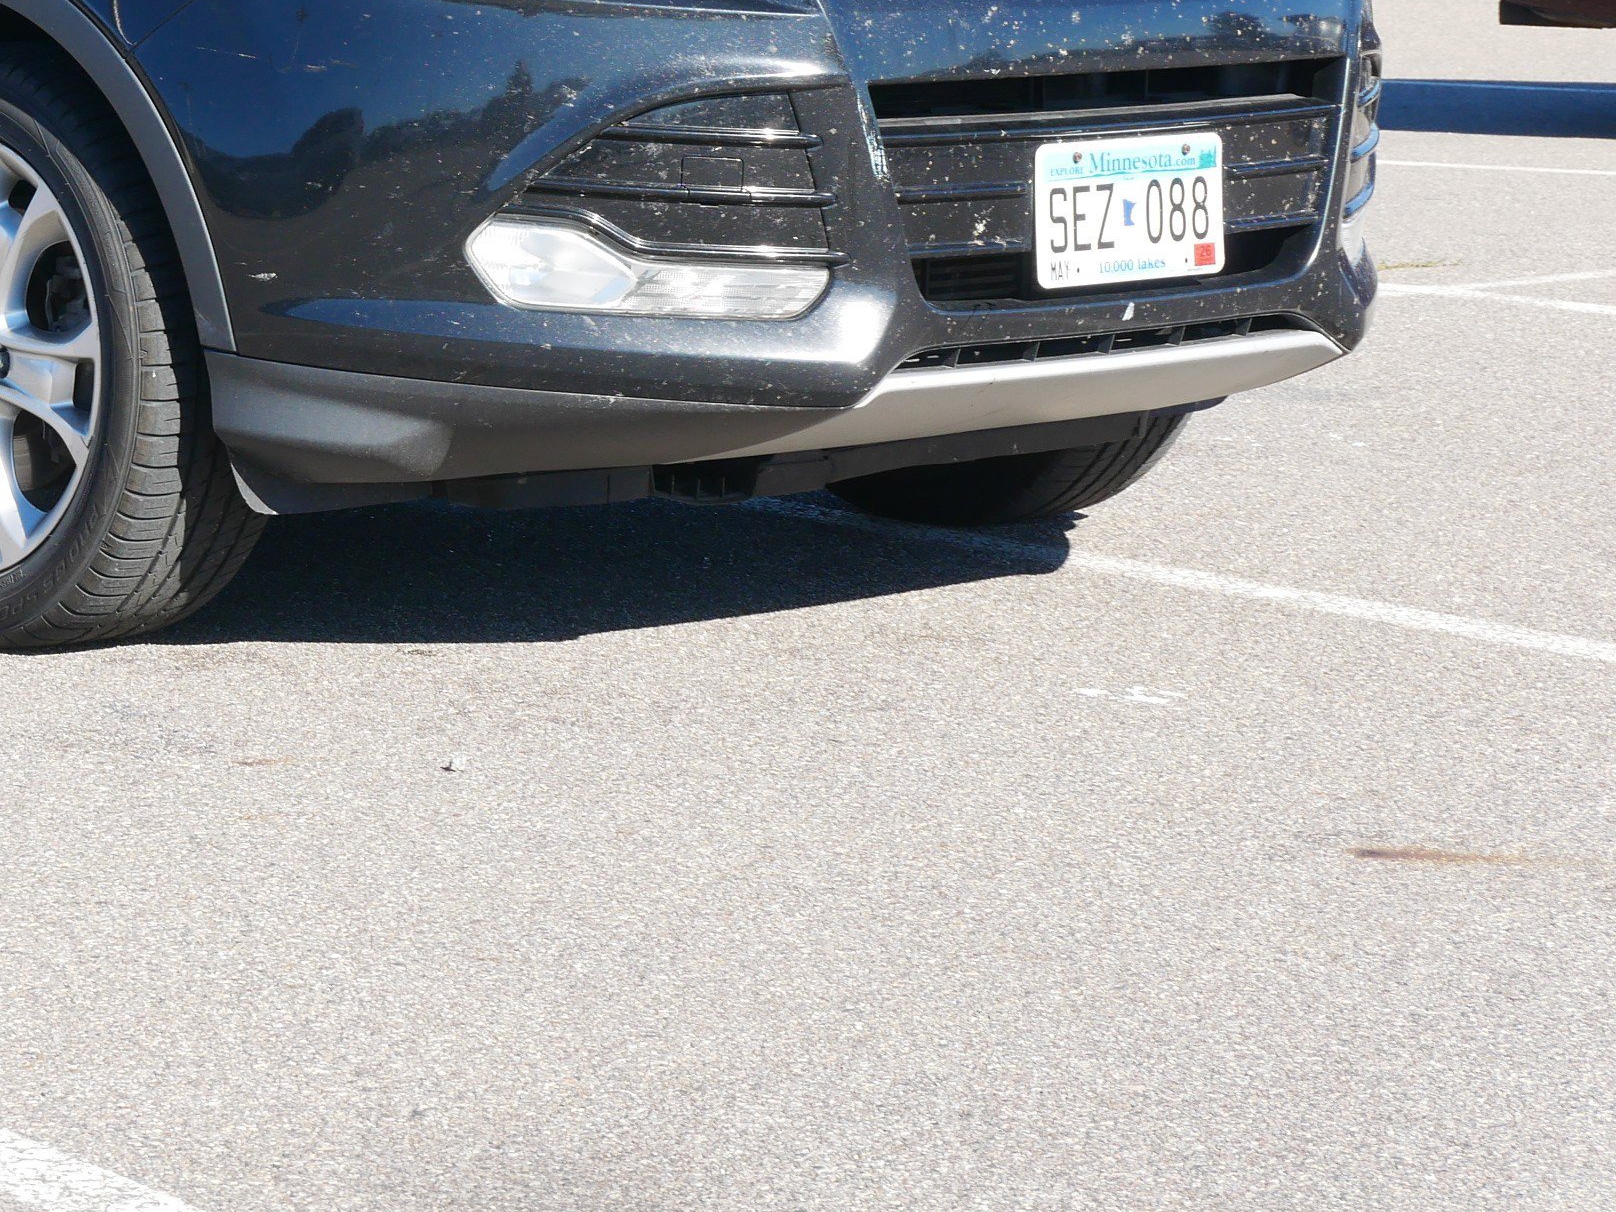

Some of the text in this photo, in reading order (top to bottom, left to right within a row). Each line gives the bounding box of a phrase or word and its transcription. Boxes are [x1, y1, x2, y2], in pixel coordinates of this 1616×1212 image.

[1050, 176, 1209, 253] SEZ 088
[1050, 259, 1070, 281] MAY
[1137, 257, 1166, 271] lakes
